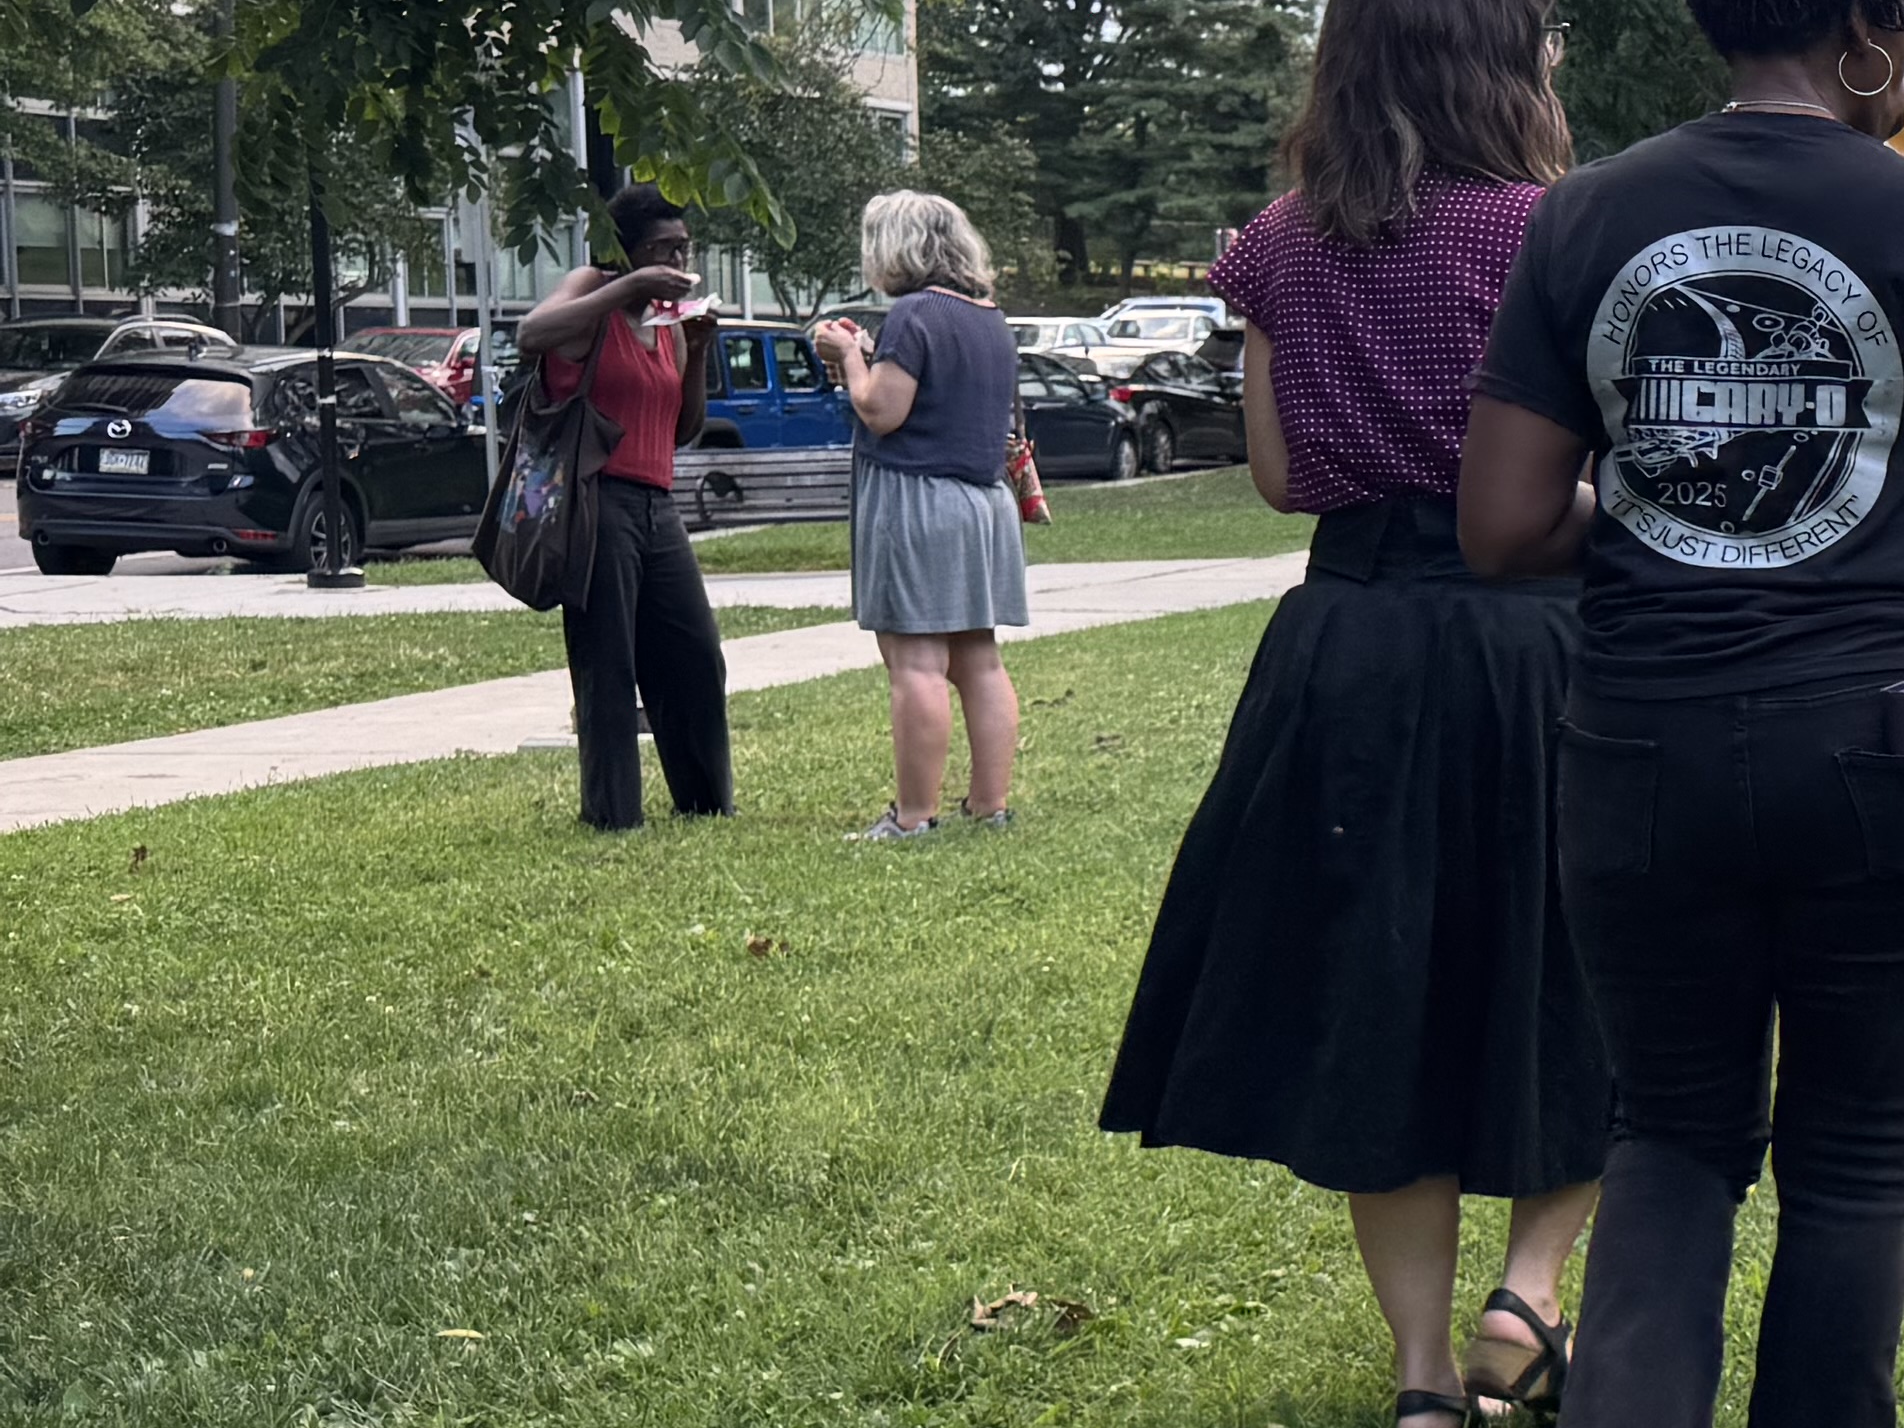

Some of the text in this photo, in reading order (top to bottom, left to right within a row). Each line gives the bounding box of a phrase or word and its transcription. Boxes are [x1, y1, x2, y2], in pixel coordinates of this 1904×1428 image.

[1603, 232, 1889, 347] HONORS THE LEGACY OF
[1648, 359, 1801, 377] THE LEGENDARY
[1657, 482, 1728, 508] 2025
[1650, 525, 1718, 560] JUST
